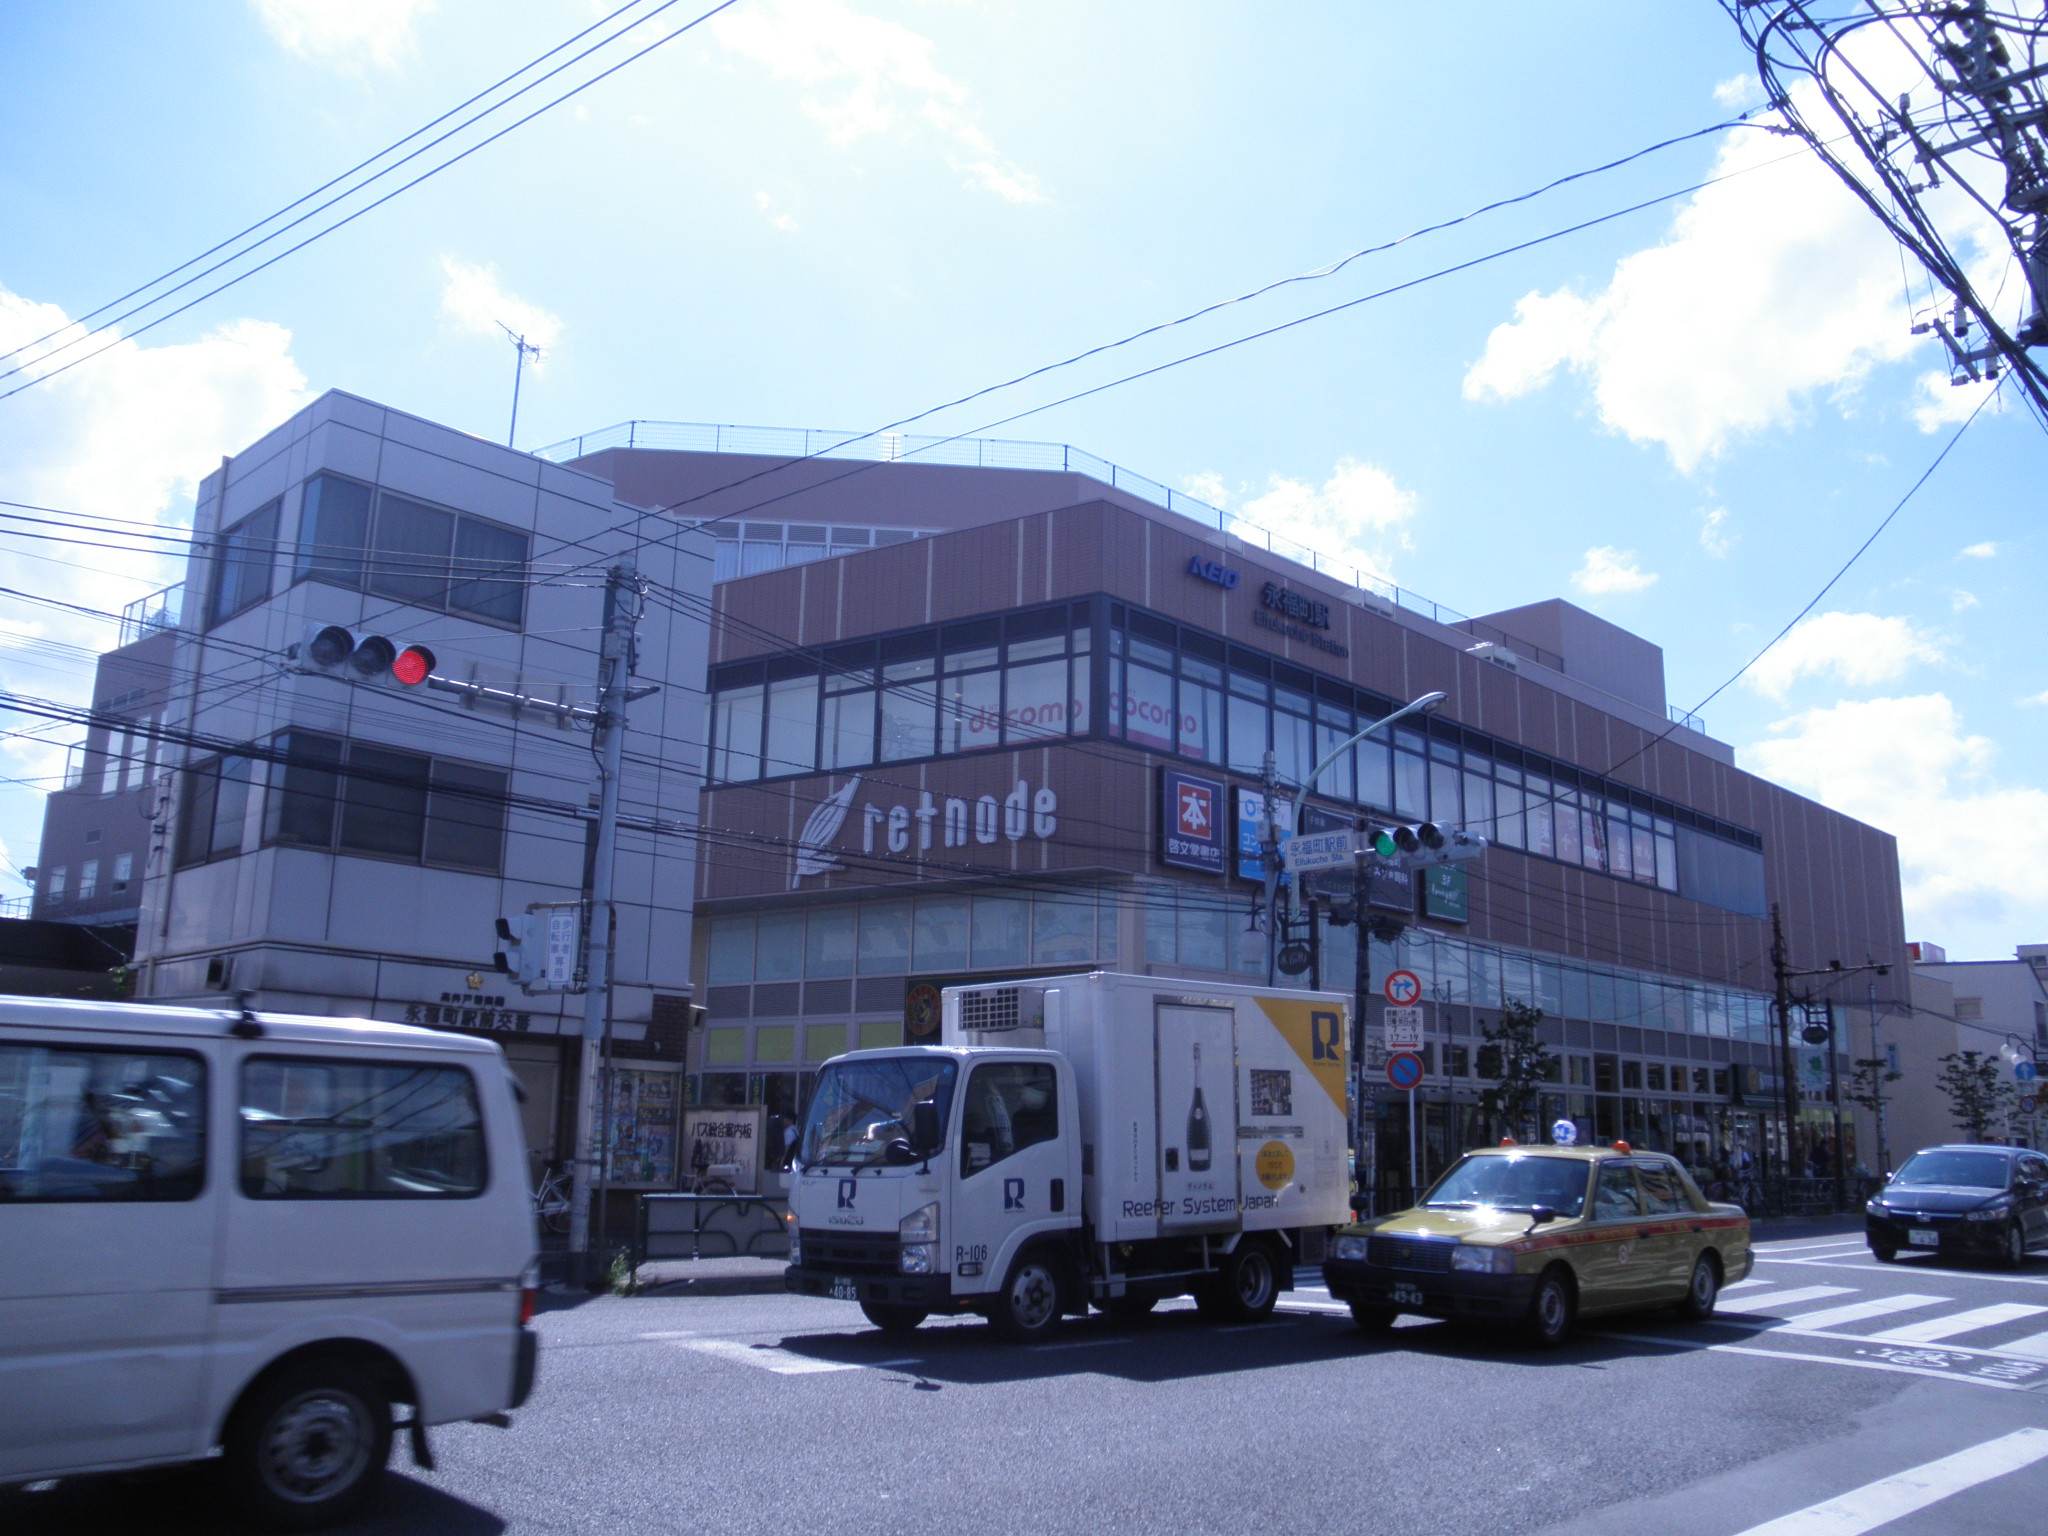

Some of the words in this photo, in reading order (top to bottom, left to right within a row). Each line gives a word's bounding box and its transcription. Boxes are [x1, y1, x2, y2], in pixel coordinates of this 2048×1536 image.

[1189, 555, 1240, 590] KEIO
[1262, 580, 1331, 631] 永福町駅
[968, 699, 1083, 734] docomo
[1181, 792, 1207, 831] 本
[1290, 835, 1348, 857] 永福町駅前
[551, 920, 560, 954] 自転車
[562, 920, 571, 954] 歩行者
[691, 1121, 753, 1139] バス総合案内板
[828, 1215, 864, 1226] ISUZU
[1123, 1200, 1175, 1218] Reefer
[1183, 1197, 1236, 1215] System
[1242, 1194, 1278, 1211] Japan
[956, 1245, 988, 1262] R-106
[833, 1285, 857, 1300] 40-85
